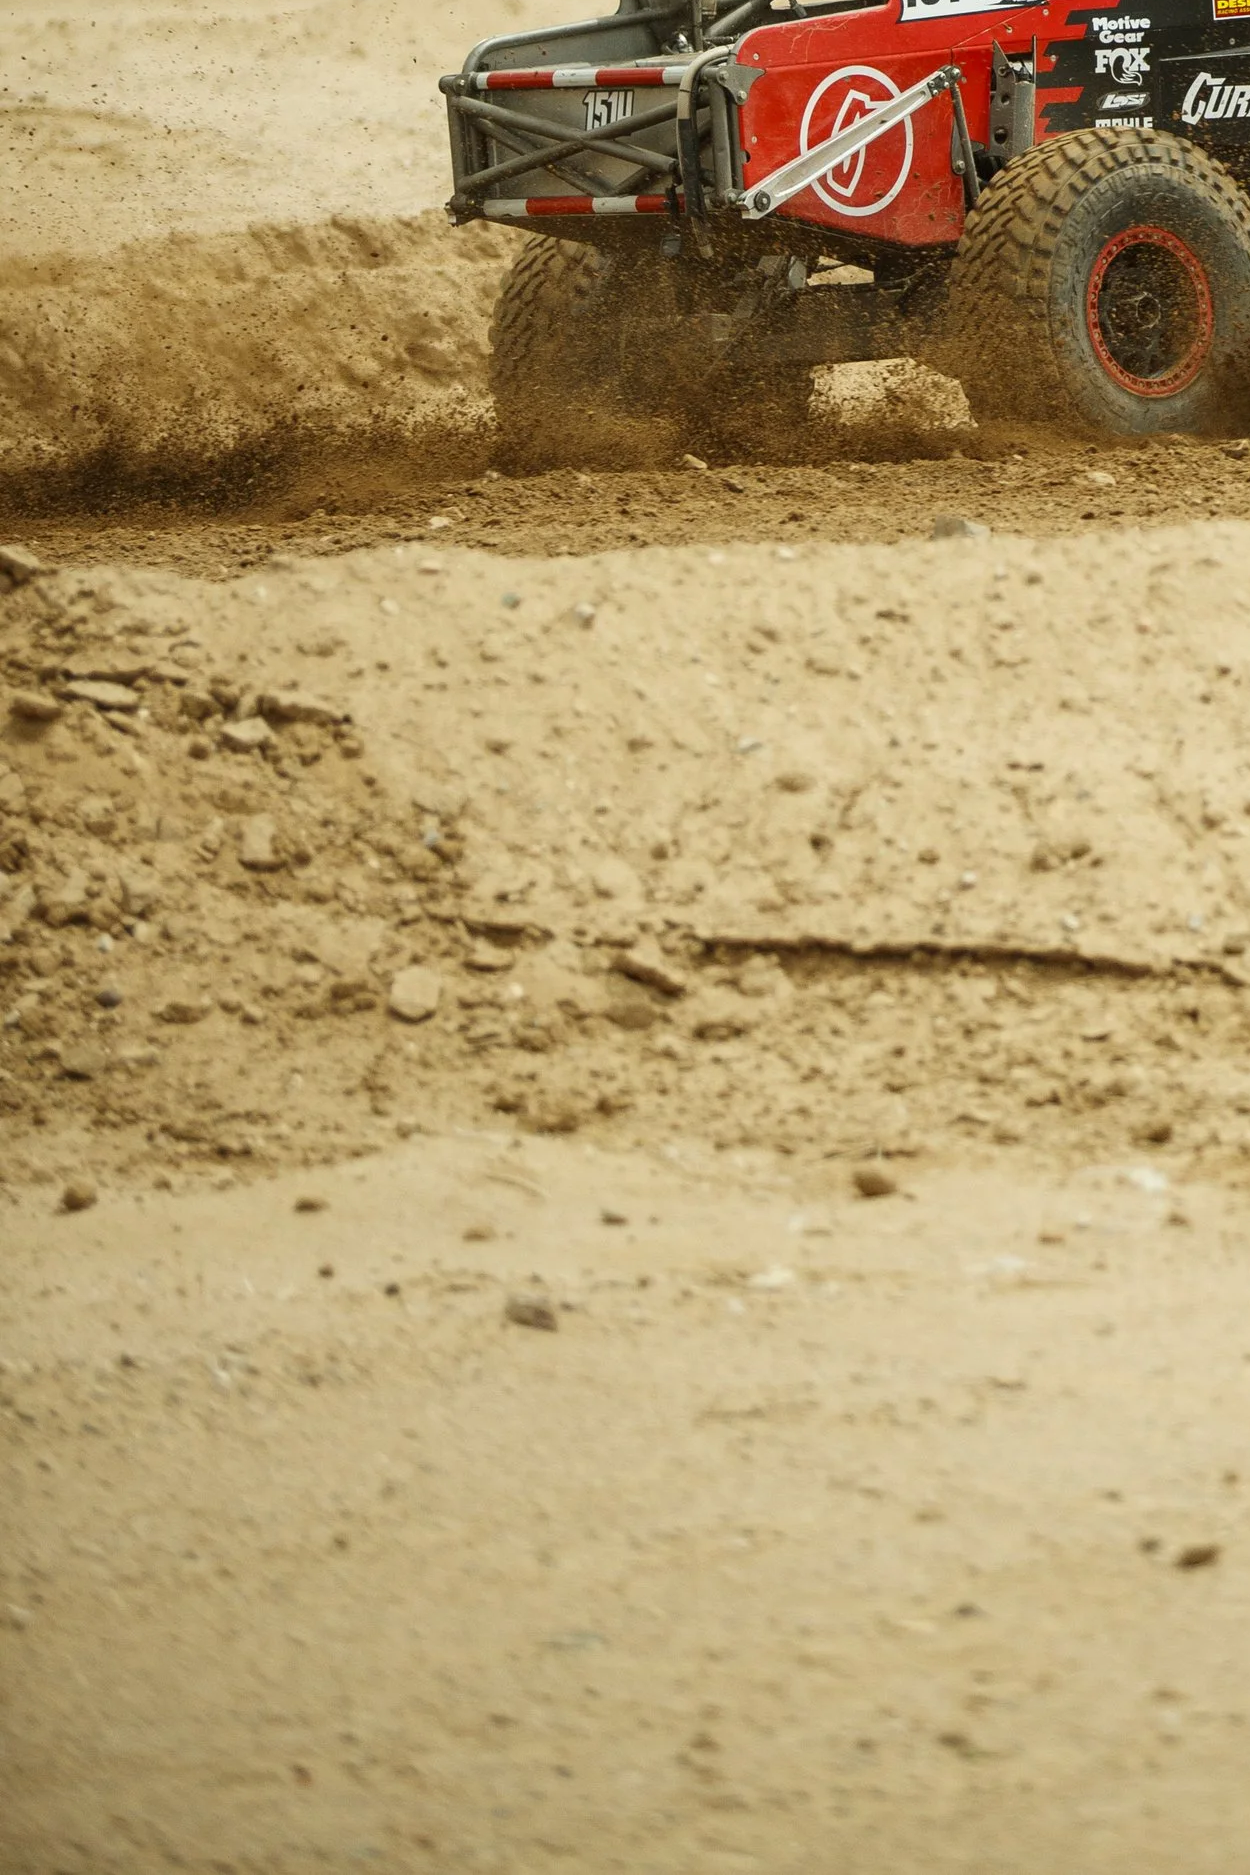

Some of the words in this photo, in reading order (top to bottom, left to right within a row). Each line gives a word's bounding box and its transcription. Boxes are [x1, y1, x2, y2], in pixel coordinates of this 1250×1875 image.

[1092, 16, 1151, 31] Motive
[1099, 30, 1145, 44] Gear
[1094, 47, 1151, 86] FOX
